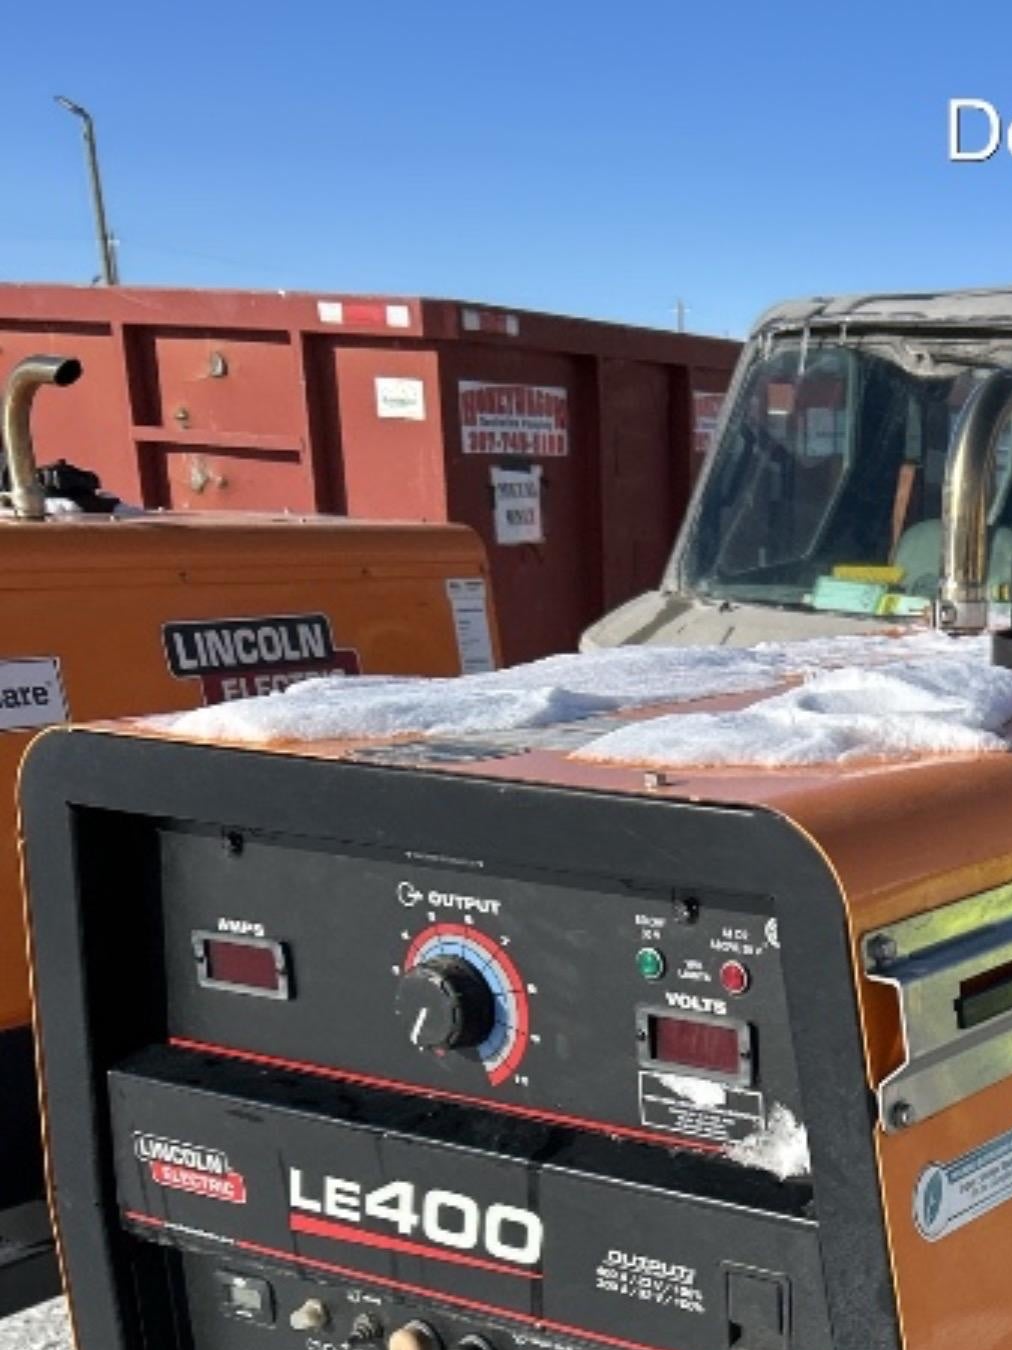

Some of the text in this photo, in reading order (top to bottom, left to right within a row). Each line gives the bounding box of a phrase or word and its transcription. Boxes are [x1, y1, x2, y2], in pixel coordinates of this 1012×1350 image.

[172, 622, 326, 671] LINCOLN
[427, 890, 501, 916] OUTPUT
[665, 992, 727, 1015] VOLTS
[139, 1137, 224, 1174] LINCOLN
[161, 1165, 236, 1198] ELECTRIC
[289, 1166, 544, 1264] LE400
[604, 1250, 692, 1282] OUTPUT
